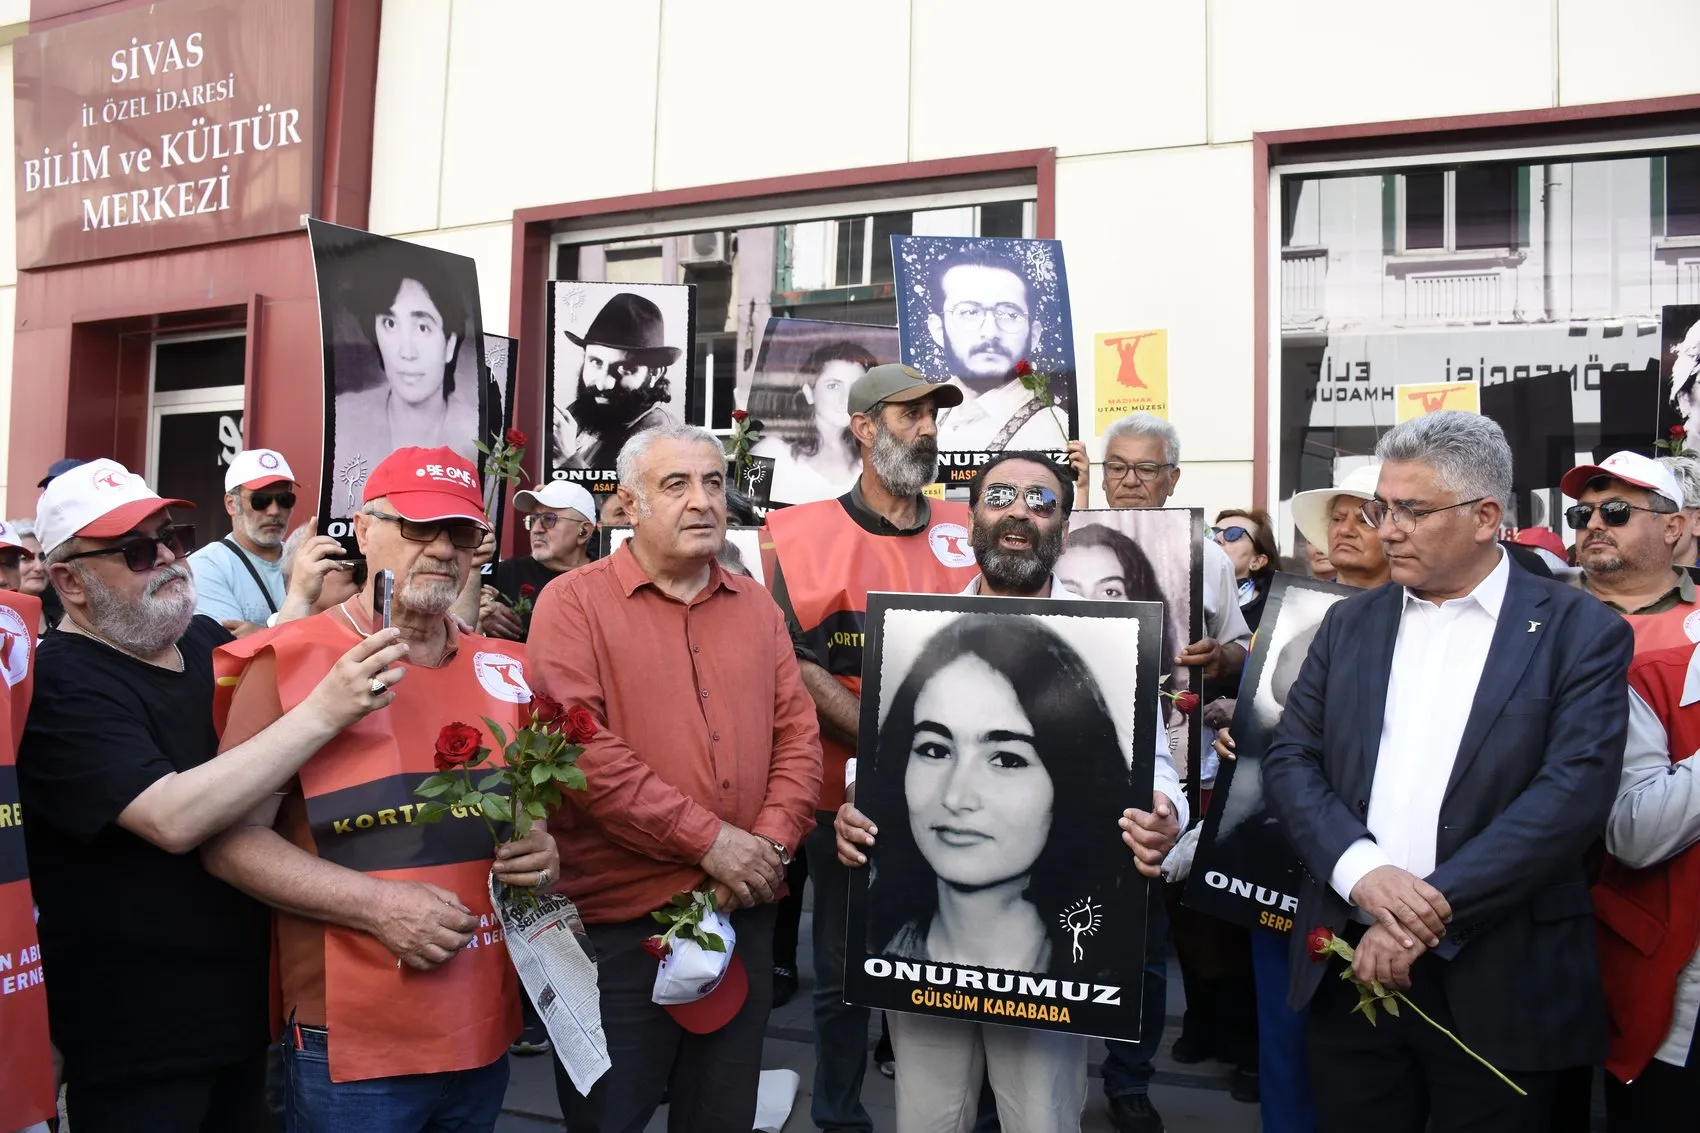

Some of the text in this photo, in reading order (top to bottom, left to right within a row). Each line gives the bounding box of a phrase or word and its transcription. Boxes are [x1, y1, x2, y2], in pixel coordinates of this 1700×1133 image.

[111, 32, 204, 84] SİVAS
[81, 73, 235, 127] İL ÖZEL İDARESİ
[24, 103, 301, 192] BİLİM ve KÜLTÜR
[82, 165, 230, 232] MERKEZİ
[1131, 403, 1165, 411] MÜZESİ
[426, 464, 444, 476] BE
[446, 466, 471, 485] ONE
[552, 470, 617, 480] ONUR
[593, 483, 615, 492] ASAF
[1204, 871, 1299, 914] ONUR
[1259, 911, 1293, 932] SERP
[3, 966, 45, 995] ERNE
[863, 958, 1121, 1006] ONURUMUZ
[911, 987, 1071, 1024] GÜLSÜM KARABABA
